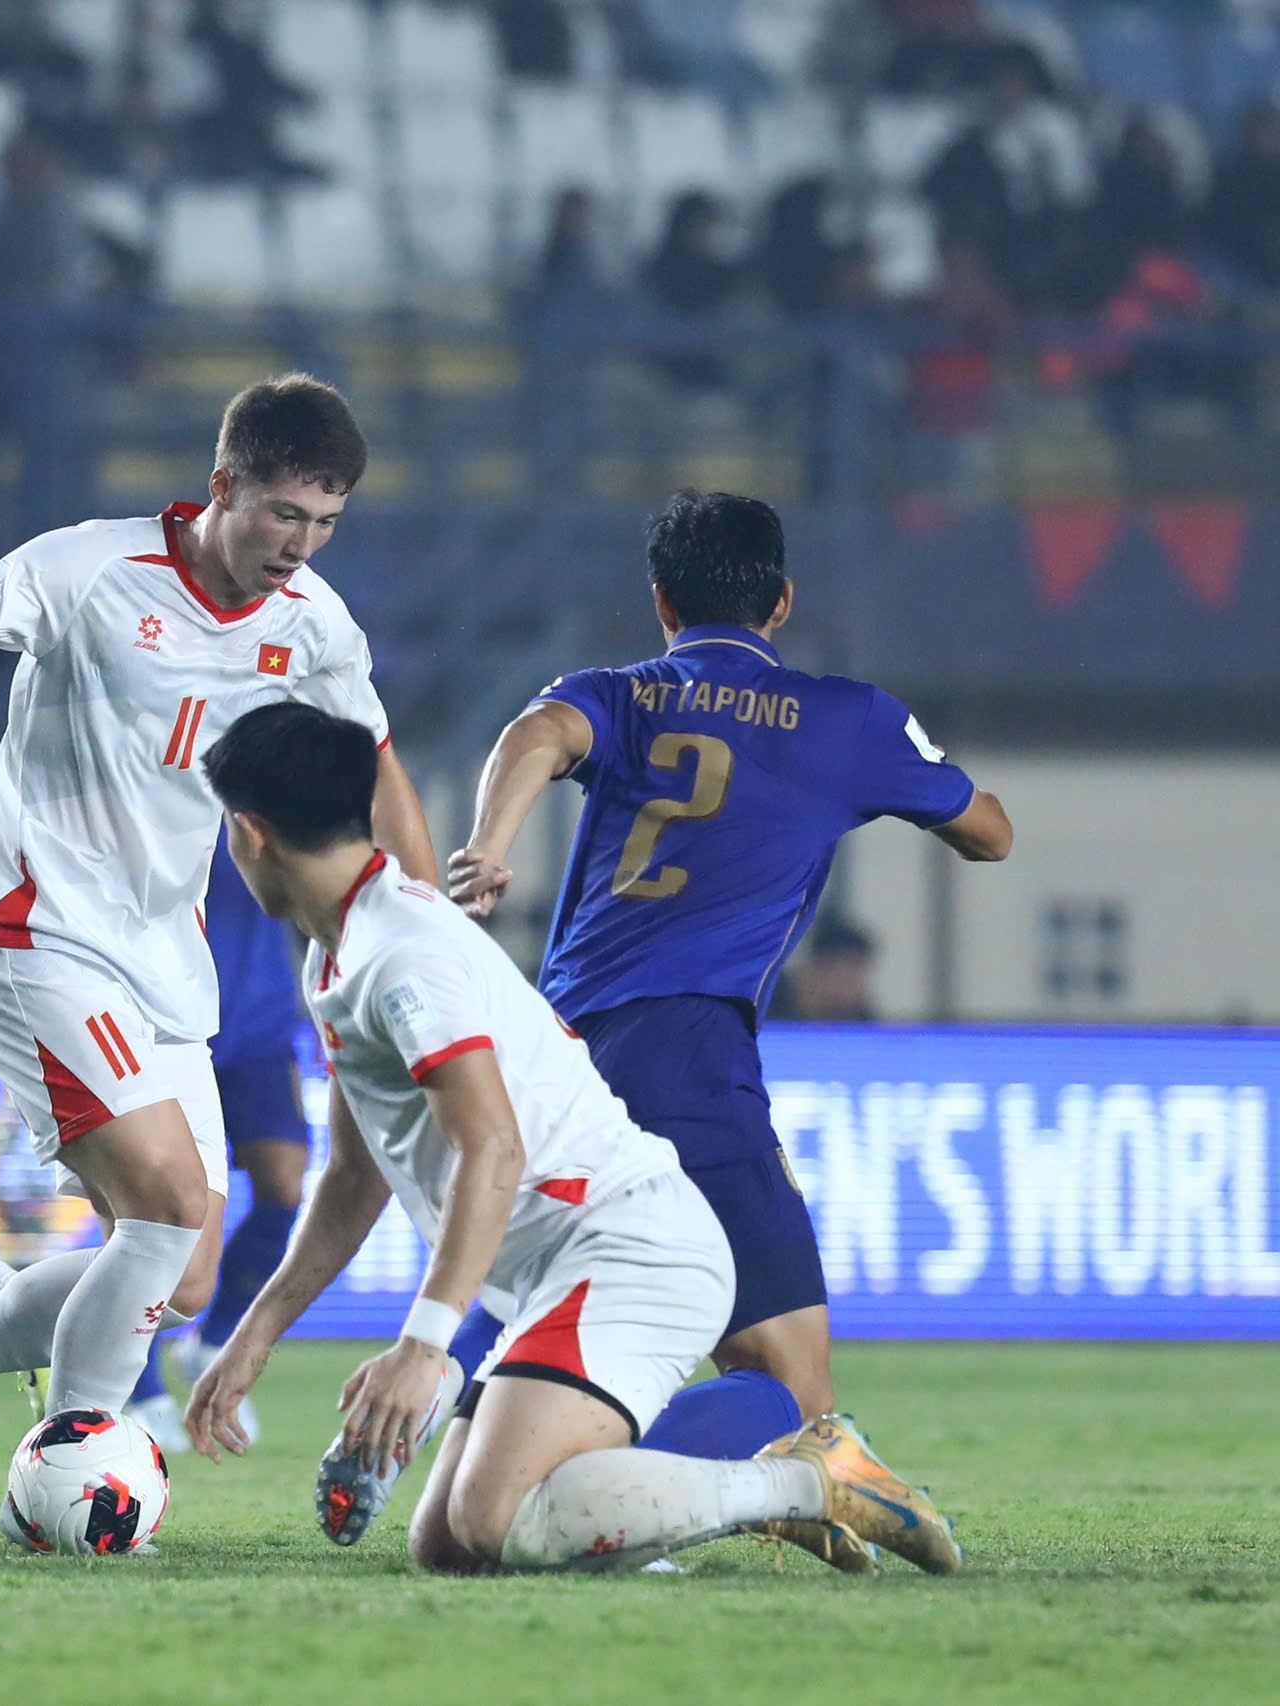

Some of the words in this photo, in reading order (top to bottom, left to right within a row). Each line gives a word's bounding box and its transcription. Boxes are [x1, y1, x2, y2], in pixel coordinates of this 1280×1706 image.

[163, 696, 207, 769] 11
[611, 732, 734, 898] 2
[86, 1011, 141, 1081] 11
